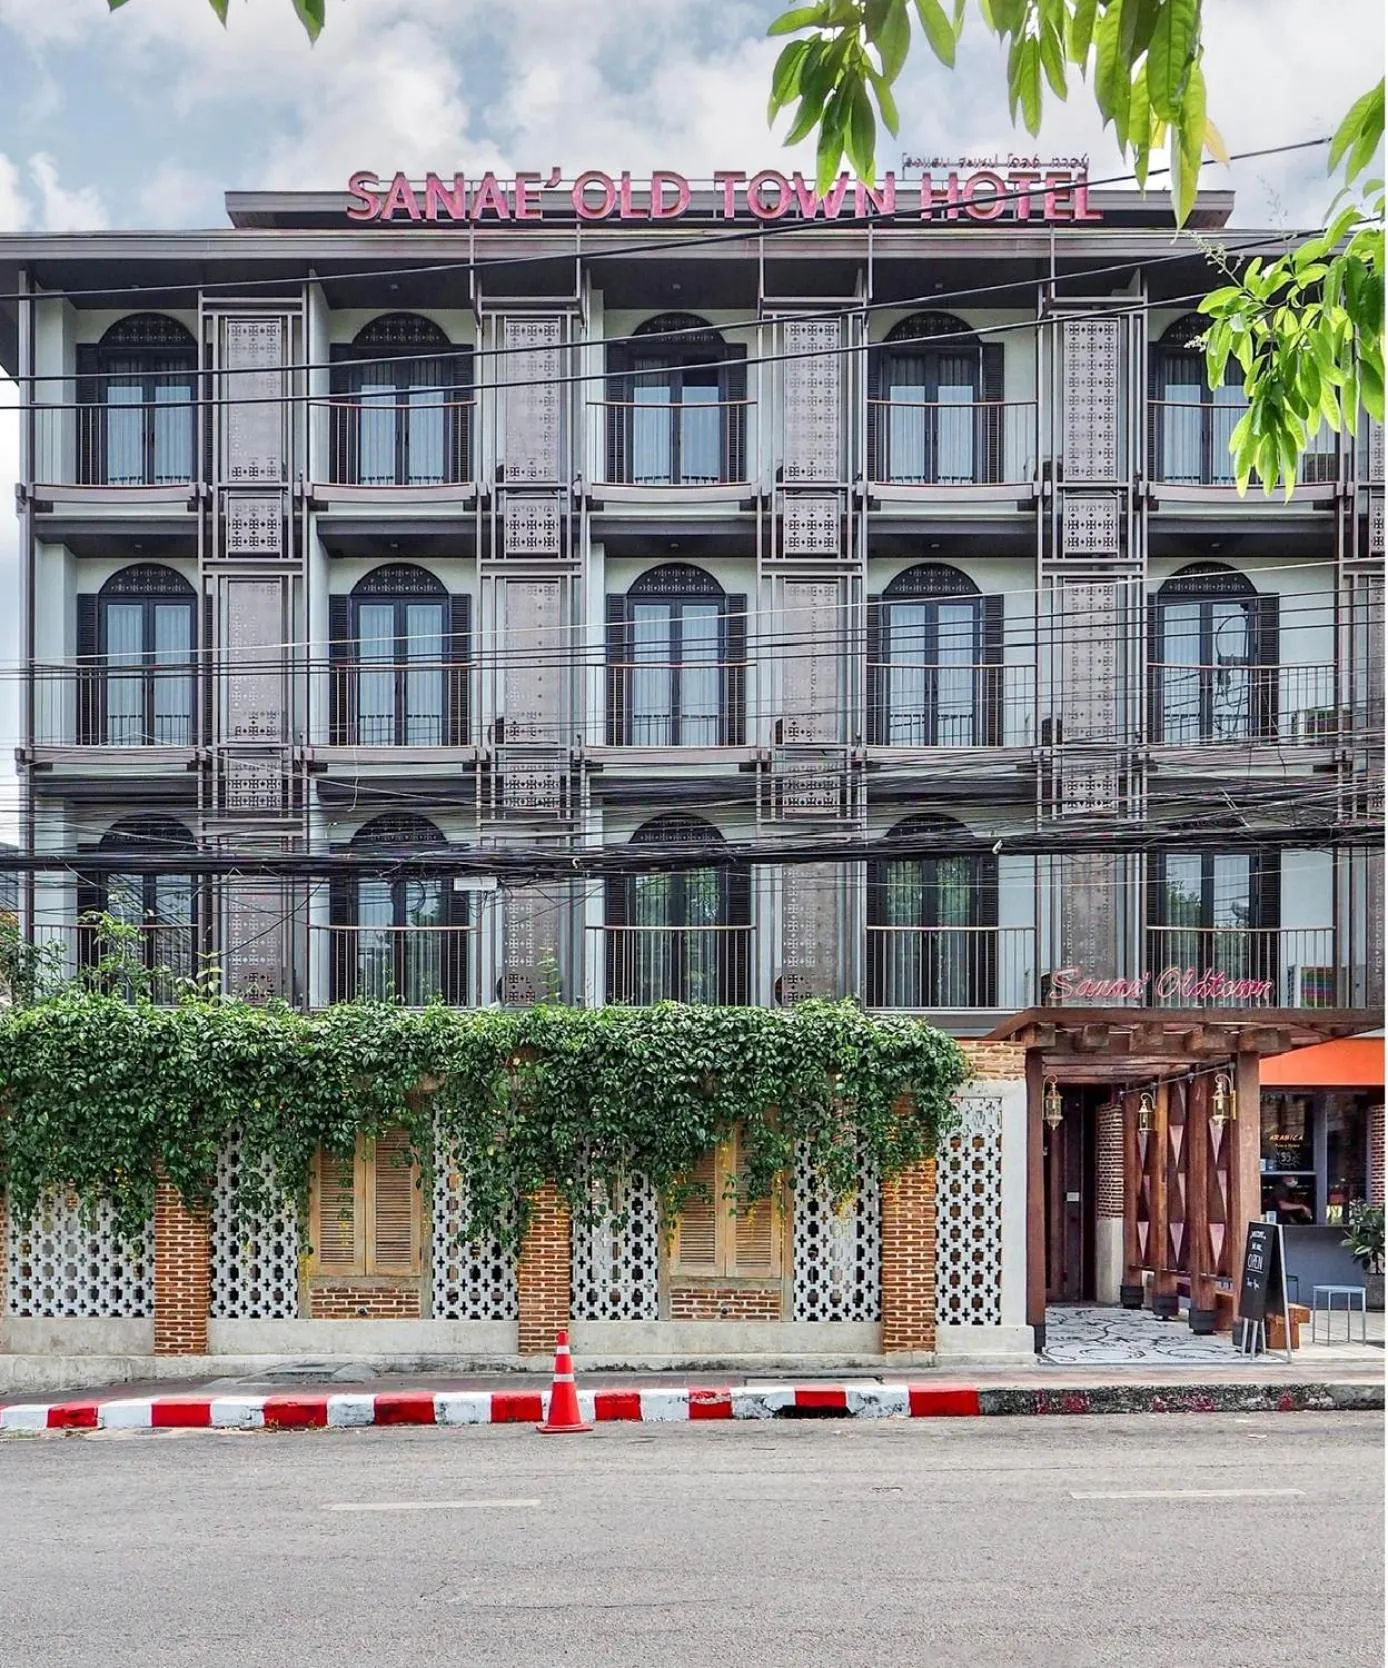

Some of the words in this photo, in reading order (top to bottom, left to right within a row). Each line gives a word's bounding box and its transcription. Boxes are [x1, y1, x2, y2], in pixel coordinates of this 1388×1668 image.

[346, 166, 562, 222] SANAE'
[572, 169, 693, 222] OLD
[713, 169, 896, 221] TOWN
[920, 168, 1104, 221] HOTEL
[1269, 1133, 1304, 1141] ARABICA
[1247, 1253, 1263, 1271] OPEN
